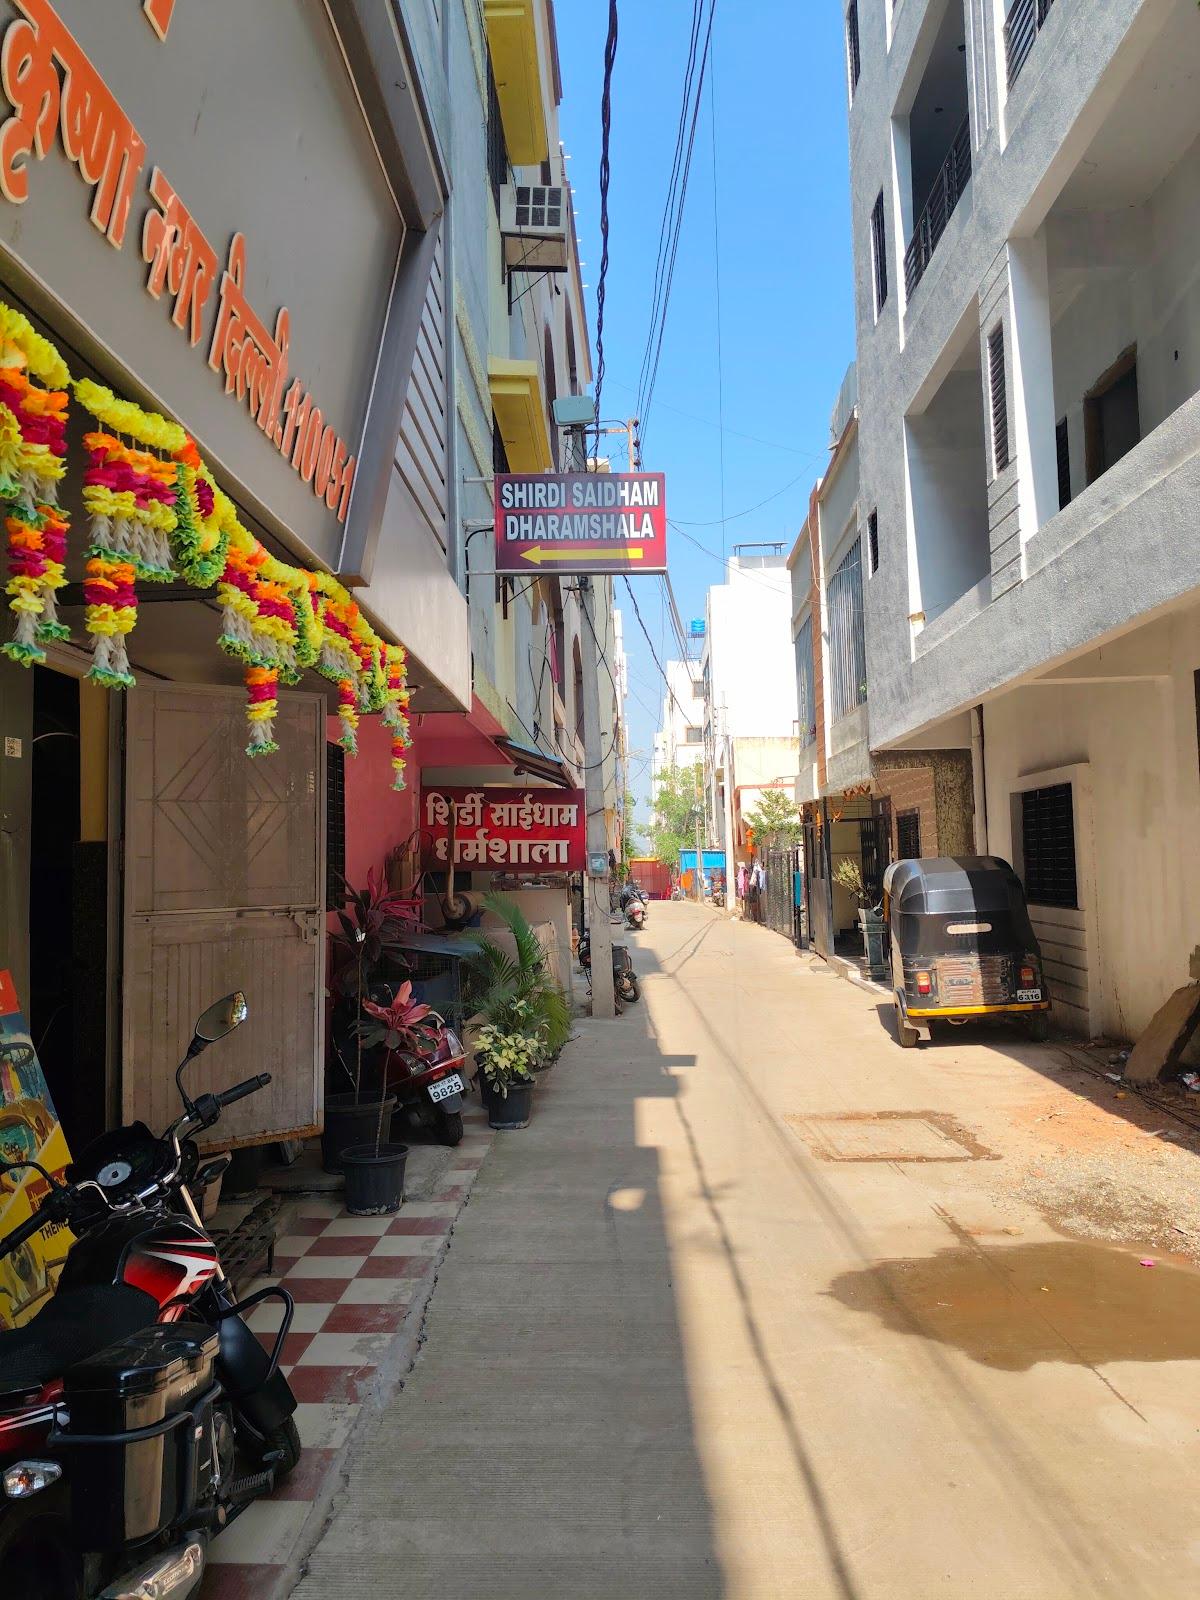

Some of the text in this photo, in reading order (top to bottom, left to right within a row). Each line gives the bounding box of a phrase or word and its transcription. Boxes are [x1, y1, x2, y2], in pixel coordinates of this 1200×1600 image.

[142, 165, 219, 348] नगर
[502, 481, 659, 508] SHIRDI SAIDHAM
[506, 513, 655, 541] DHARAMSHALA
[489, 793, 578, 831] साईधाम
[435, 828, 570, 864] धर्मशाला
[432, 1081, 462, 1100] 9825
